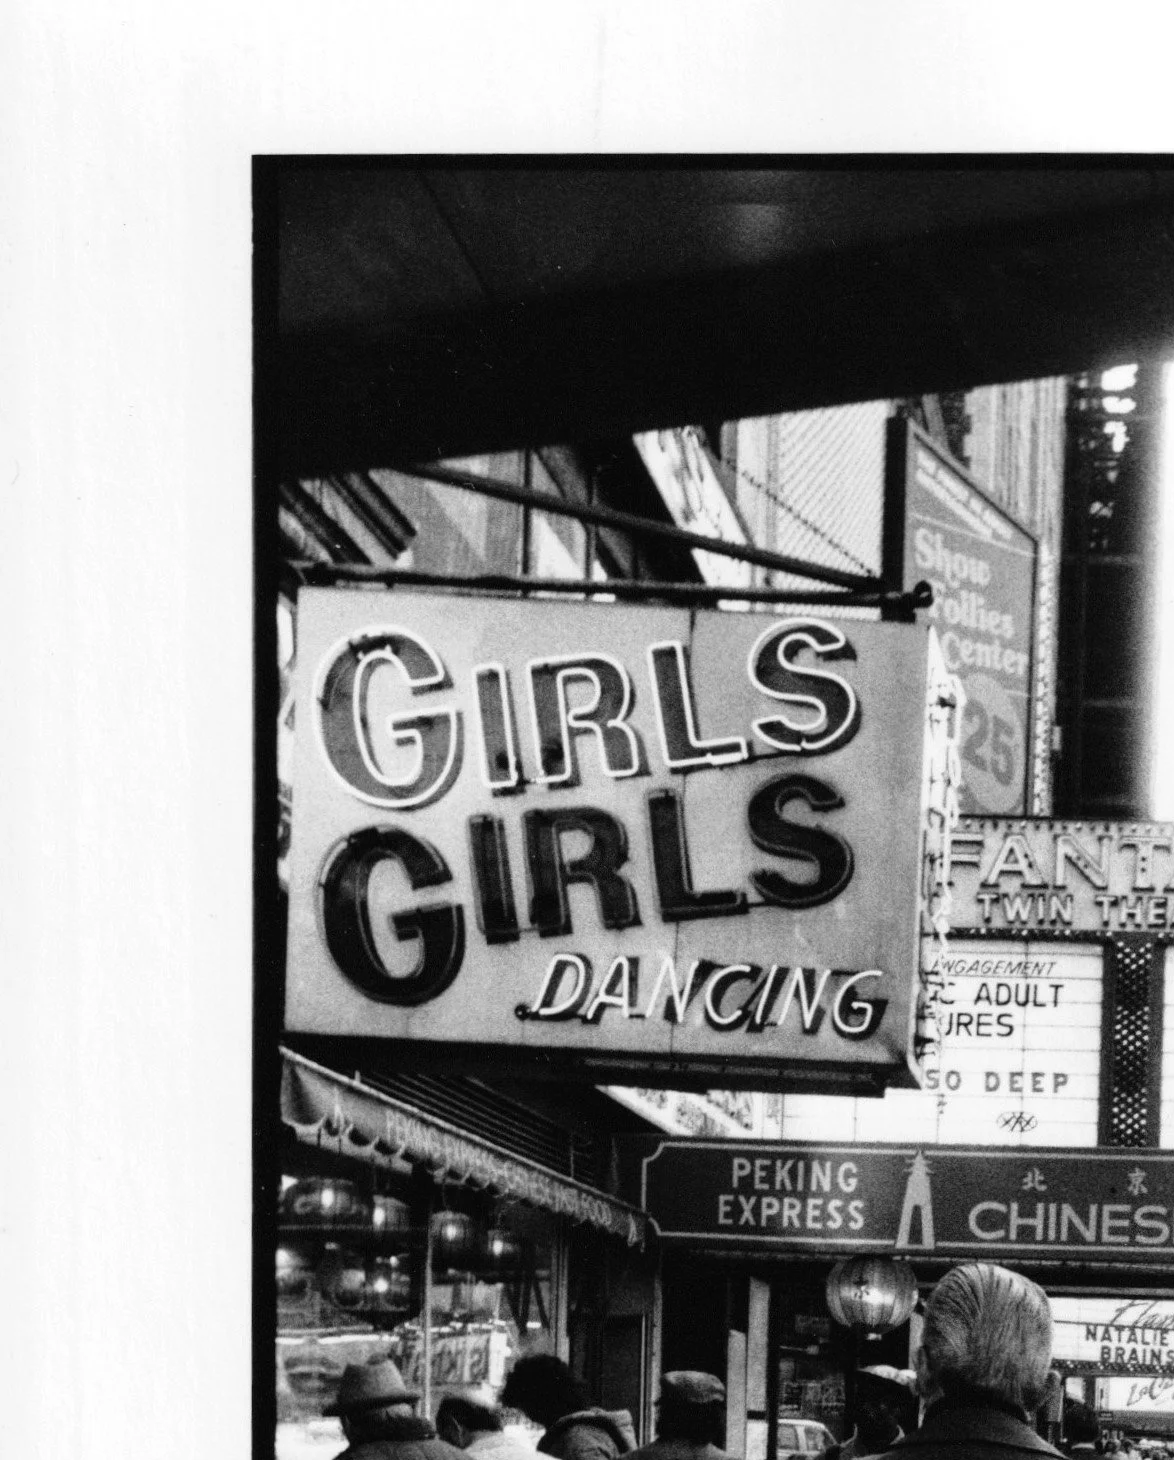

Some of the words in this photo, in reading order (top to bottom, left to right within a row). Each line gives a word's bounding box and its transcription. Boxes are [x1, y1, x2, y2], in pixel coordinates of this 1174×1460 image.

[914, 527, 991, 589] Show
[940, 630, 1030, 676] Center
[312, 616, 862, 811] GIRLS
[317, 773, 856, 1007] GIRLS
[976, 893, 1073, 925] TWIN
[520, 953, 889, 1042] DANCING
[973, 982, 1065, 1008] ADULT
[925, 1068, 962, 1092] SO
[984, 1071, 1069, 1094] DEEP
[732, 1156, 859, 1193] PEKING
[717, 1193, 866, 1231] EXPRESS
[1085, 1325, 1170, 1347] NATALIE
